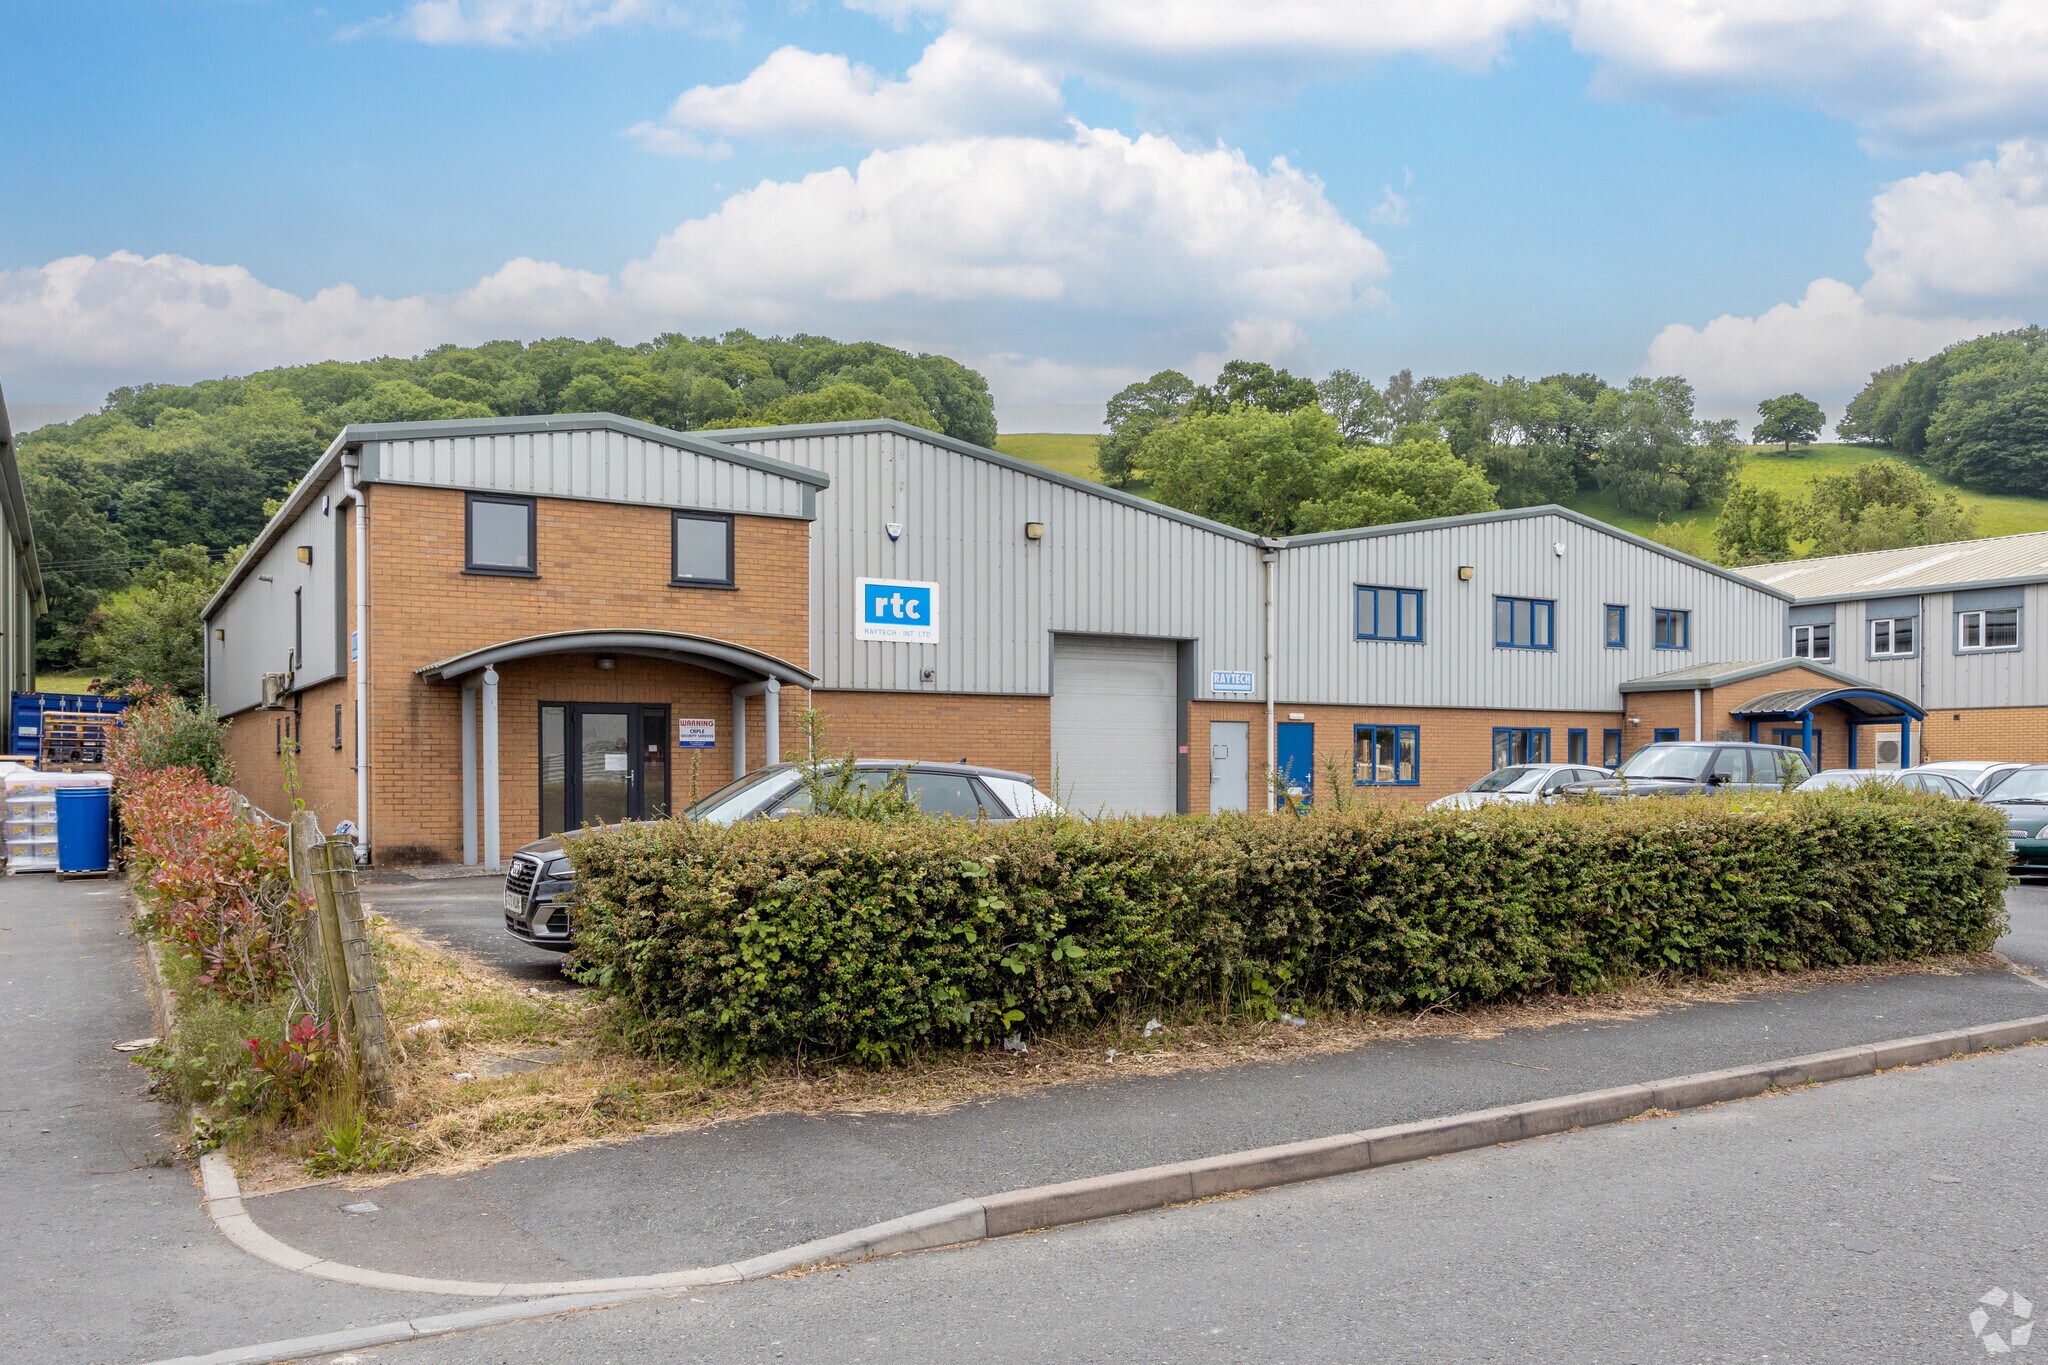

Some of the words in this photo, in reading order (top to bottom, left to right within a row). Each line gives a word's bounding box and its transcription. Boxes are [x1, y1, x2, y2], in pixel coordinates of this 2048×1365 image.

[875, 592, 921, 620] rtc
[864, 628, 897, 636] RAYTECH
[1214, 673, 1251, 685] RAYTECH
